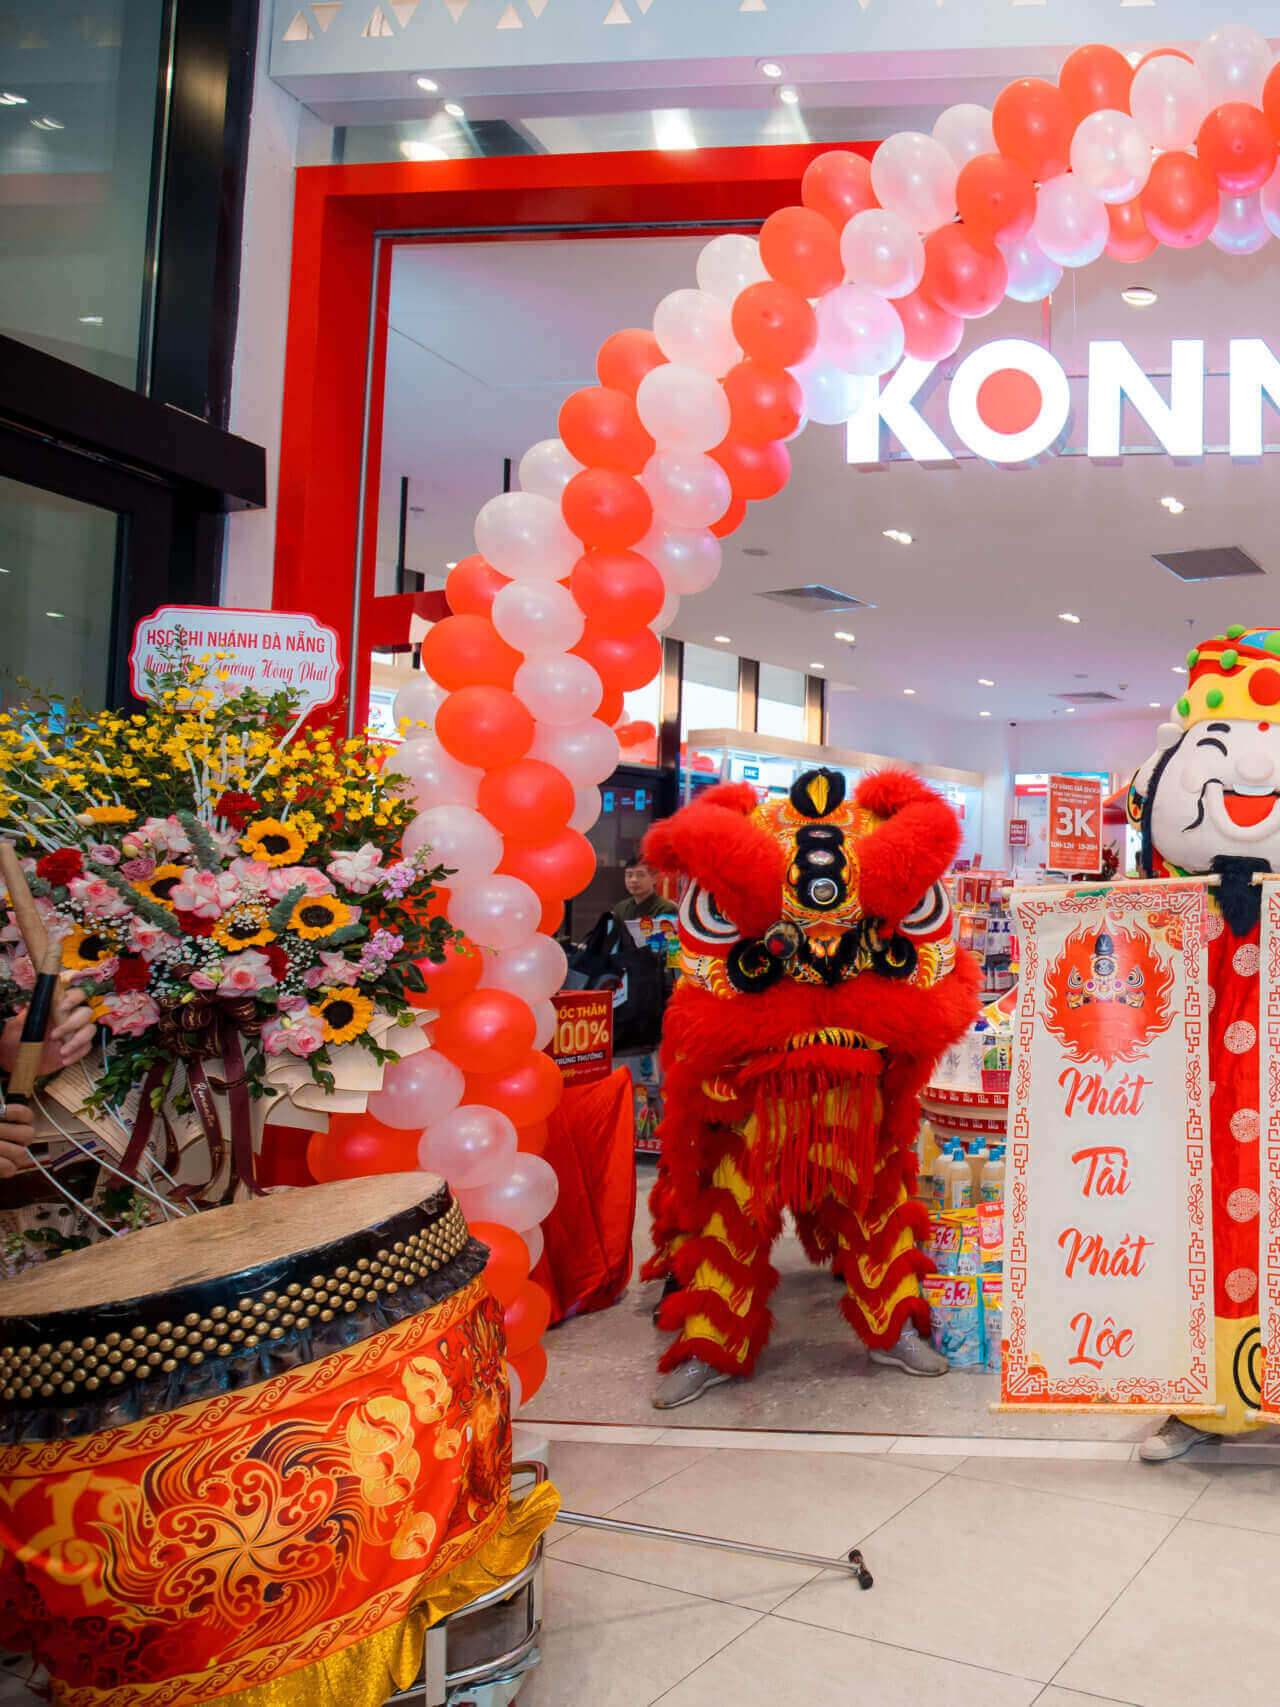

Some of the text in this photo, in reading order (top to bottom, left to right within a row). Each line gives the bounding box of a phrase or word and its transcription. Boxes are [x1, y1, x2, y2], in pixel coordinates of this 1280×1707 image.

[147, 629, 175, 646] HSC
[180, 630, 203, 647] CHI
[208, 629, 258, 649] NHÁNH
[262, 632, 281, 650] ĐÀ
[1055, 806, 1096, 837] 3K
[556, 1002, 607, 1020] ỐC THĂM
[1058, 1066, 1154, 1118] Phát
[1071, 1146, 1131, 1198] Tài
[1058, 1227, 1156, 1279] Phát
